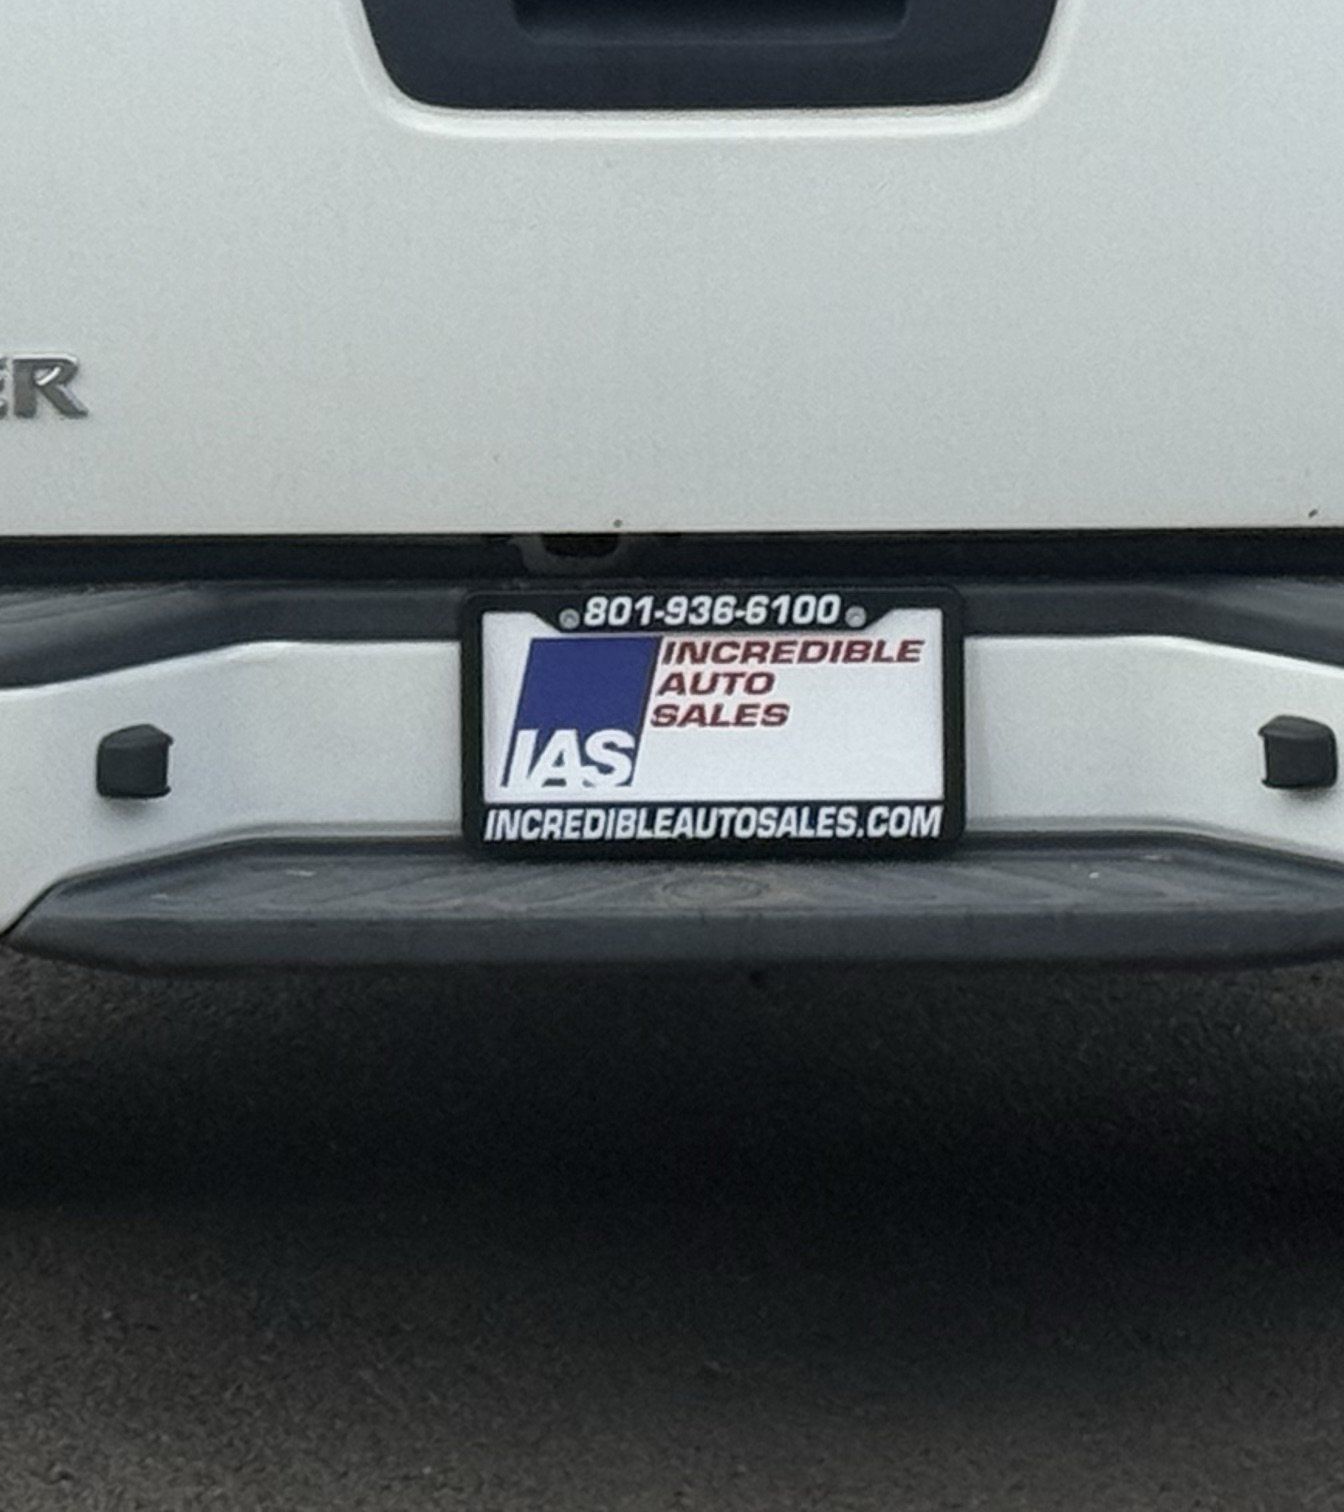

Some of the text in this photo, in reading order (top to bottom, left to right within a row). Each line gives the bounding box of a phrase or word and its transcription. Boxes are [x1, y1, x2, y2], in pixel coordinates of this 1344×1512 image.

[584, 594, 841, 626] 801-936-6100
[661, 639, 924, 664] INCREDIBLE
[656, 671, 776, 696] AUTO
[650, 703, 790, 727] SALES
[506, 729, 636, 787] IAS
[484, 805, 943, 840] INCREDIBLEAUTOSALES.COM
